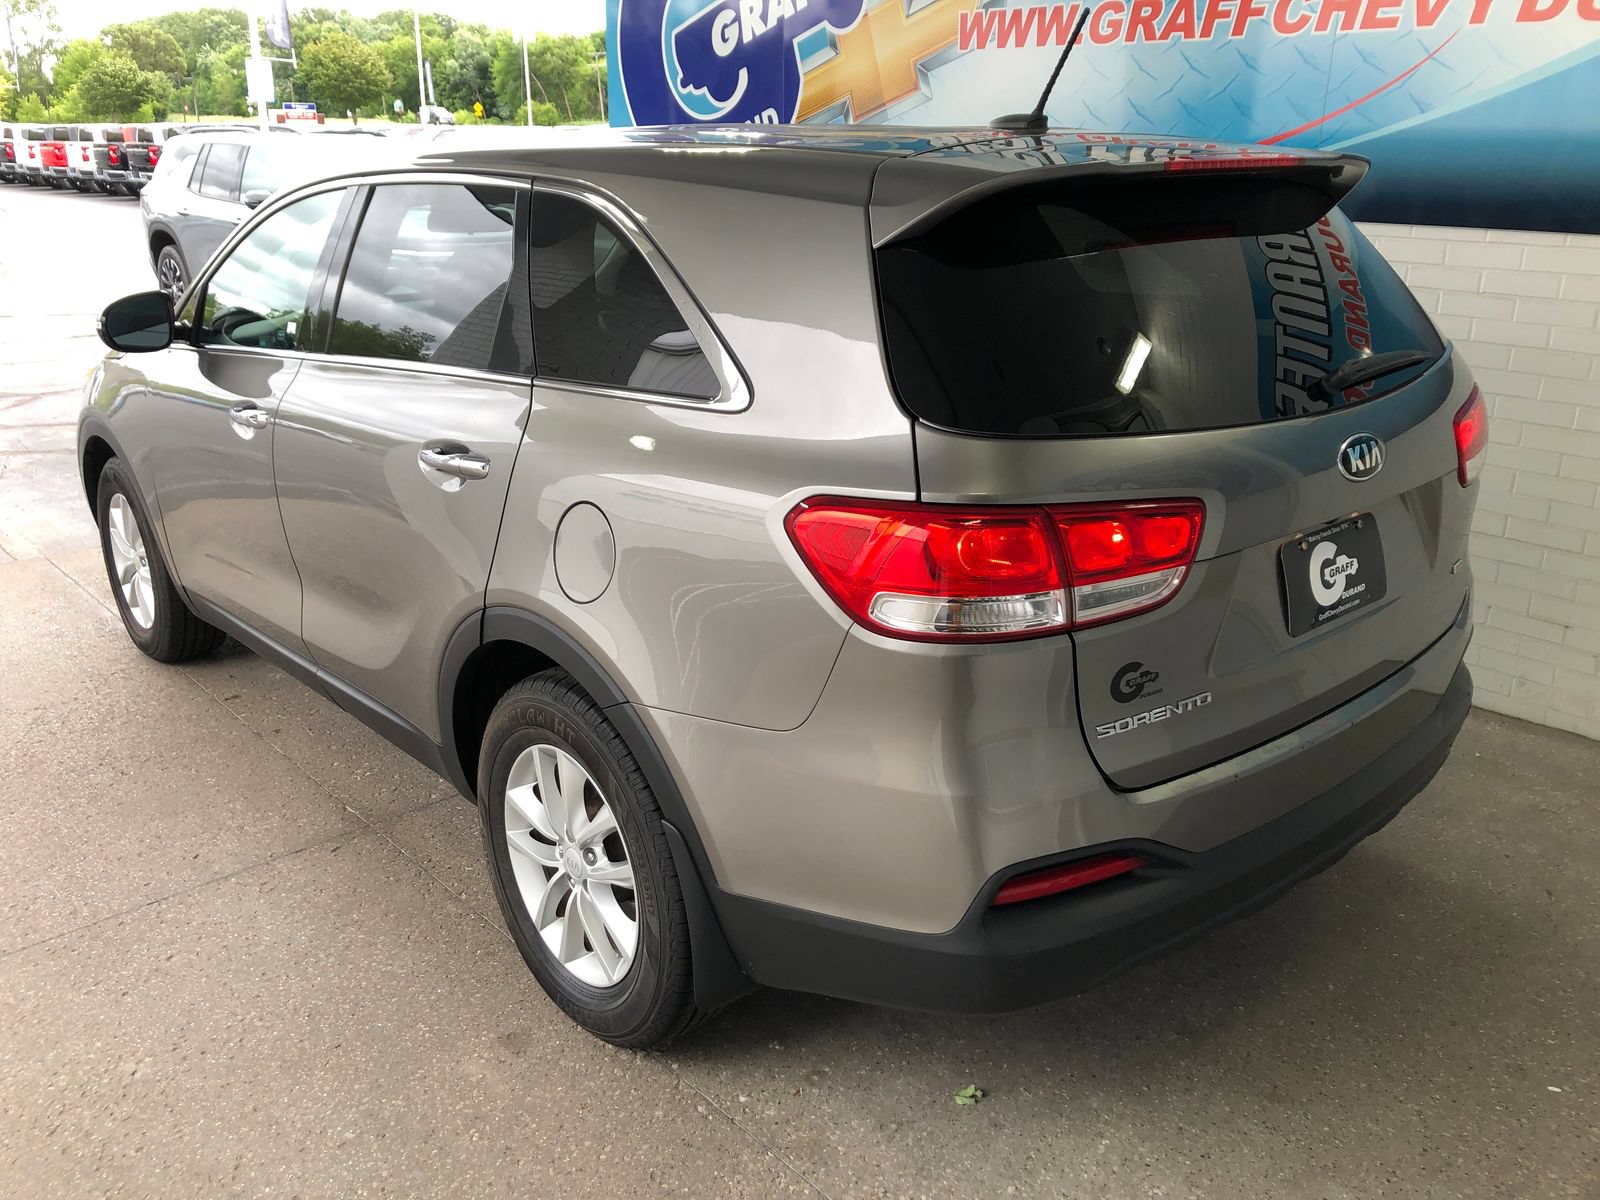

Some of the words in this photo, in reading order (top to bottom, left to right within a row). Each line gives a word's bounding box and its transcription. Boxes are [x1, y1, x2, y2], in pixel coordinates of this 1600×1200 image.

[1329, 560, 1356, 579] GRAFF
[1341, 583, 1366, 600] DURAND
[1129, 671, 1158, 687] GRAFF
[1096, 691, 1212, 739] SORENTO
